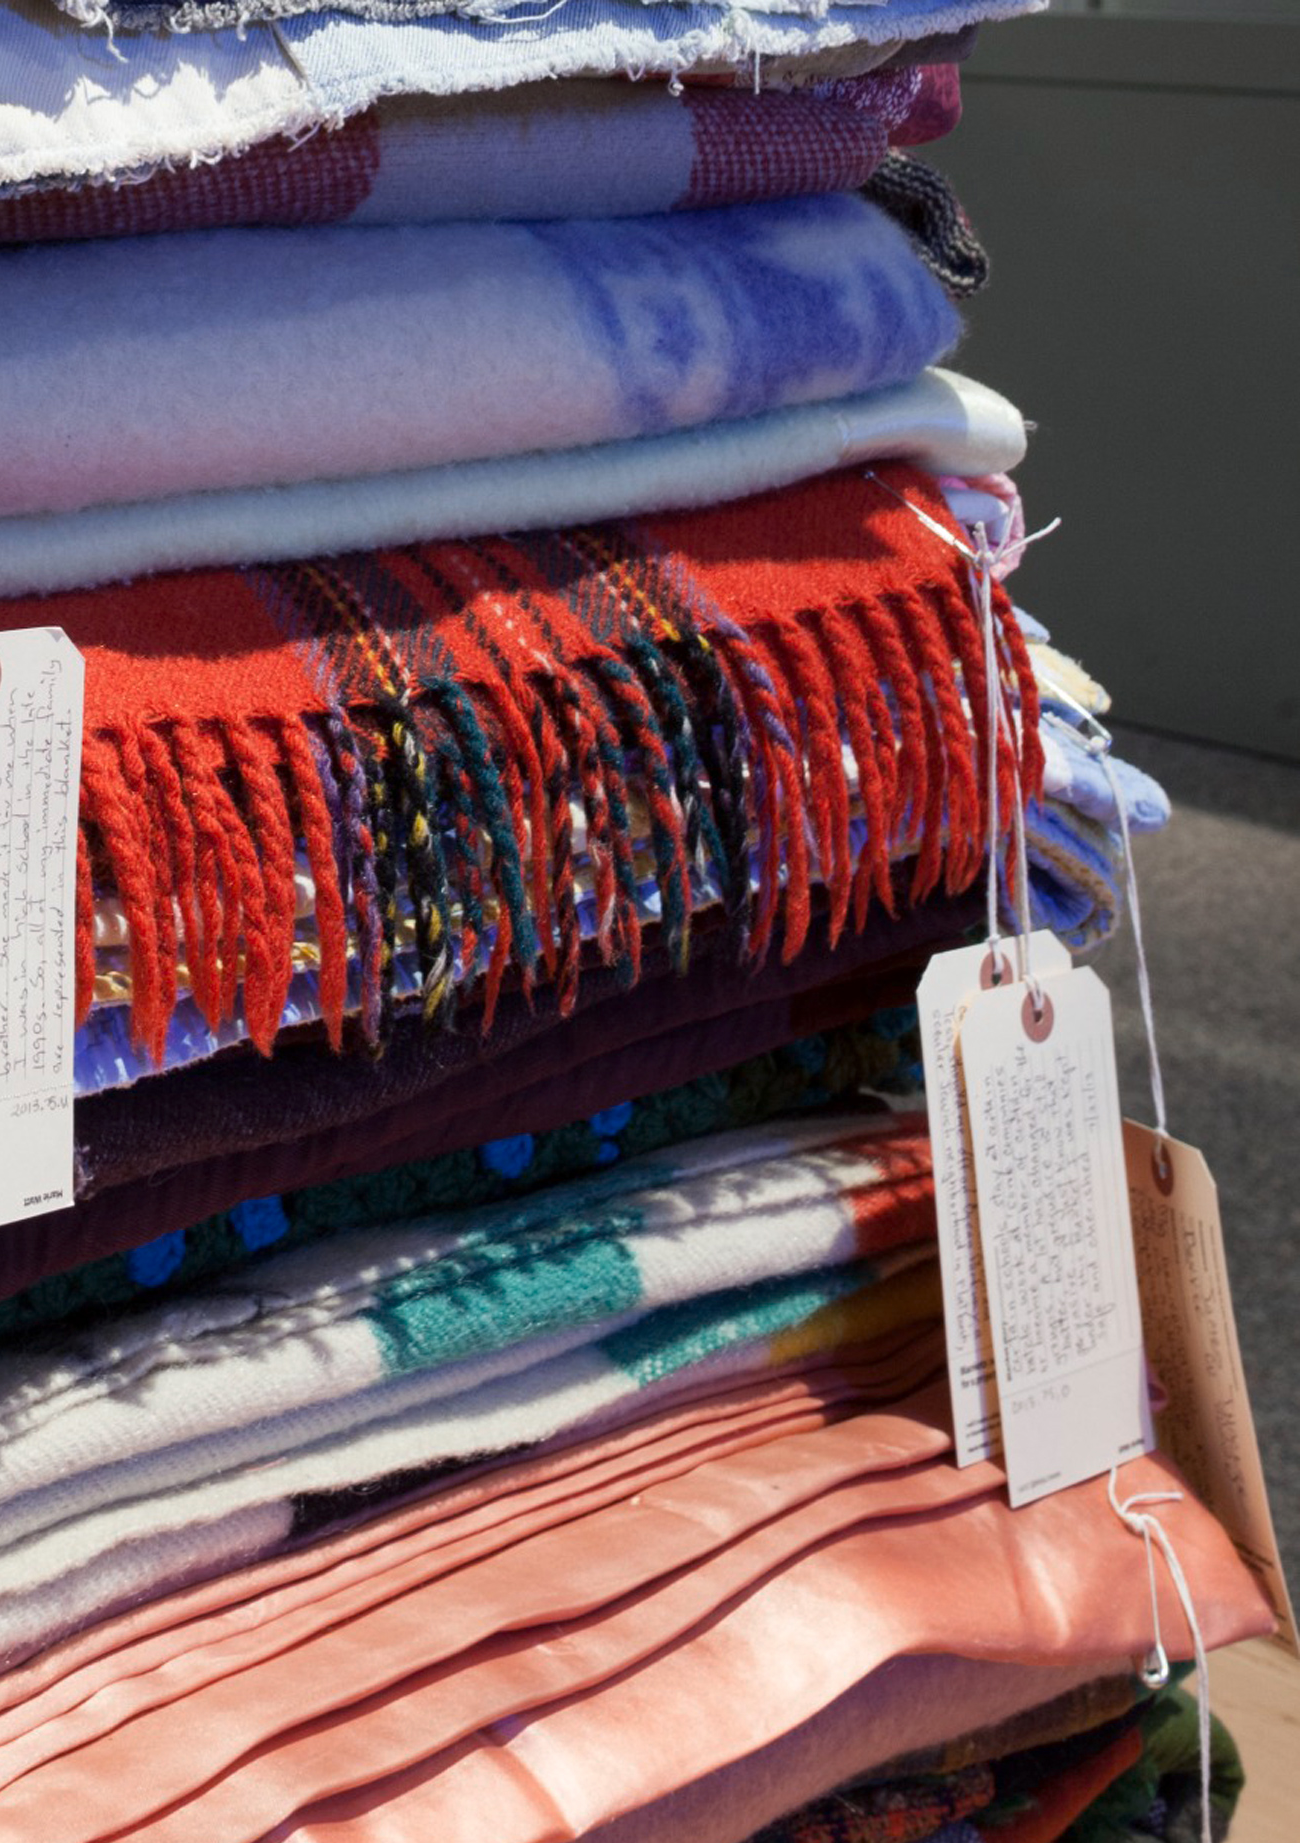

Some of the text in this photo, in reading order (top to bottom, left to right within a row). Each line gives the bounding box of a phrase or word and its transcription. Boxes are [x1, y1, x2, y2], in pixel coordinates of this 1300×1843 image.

[4, 759, 13, 787] me
[9, 689, 35, 1038] was in high the late
[28, 658, 61, 1070] 1990s. So, all my immediate family
[48, 707, 72, 1074] are represented this blanket.
[22, 1189, 64, 1207] Marie Watt
